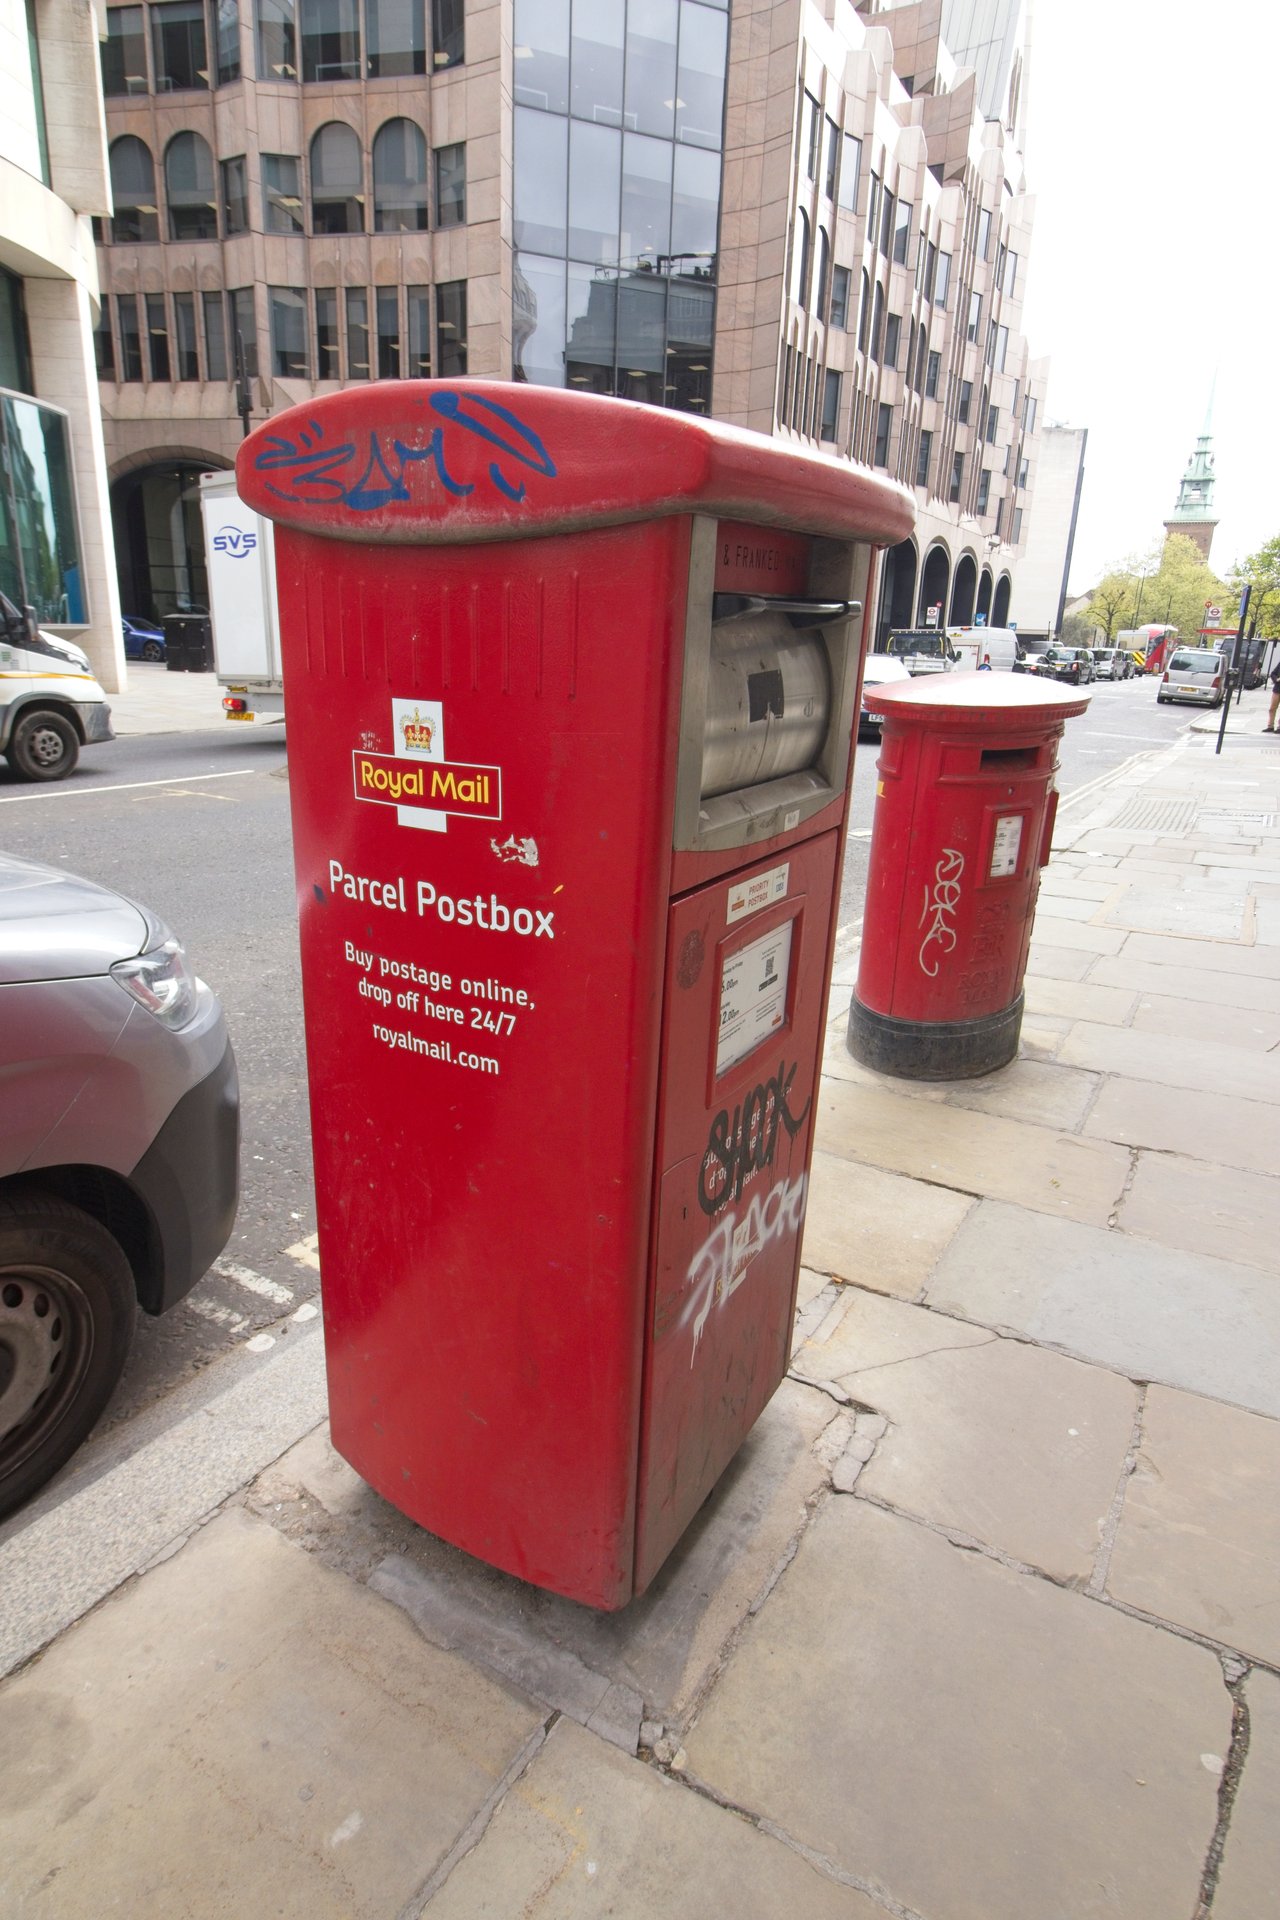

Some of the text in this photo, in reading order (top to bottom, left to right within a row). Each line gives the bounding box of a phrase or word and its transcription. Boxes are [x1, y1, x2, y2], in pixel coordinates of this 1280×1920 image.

[213, 533, 257, 551] SVS
[723, 543, 730, 566] &
[360, 760, 490, 804] Royal Mail
[329, 858, 556, 939] Parcel Postbox
[747, 891, 769, 908] POSTBOX
[748, 879, 769, 896] PRIORITY
[345, 940, 536, 1010] Buy postage online,
[358, 976, 517, 1036] drop off here 24/7
[372, 1022, 500, 1075] royalmail.com
